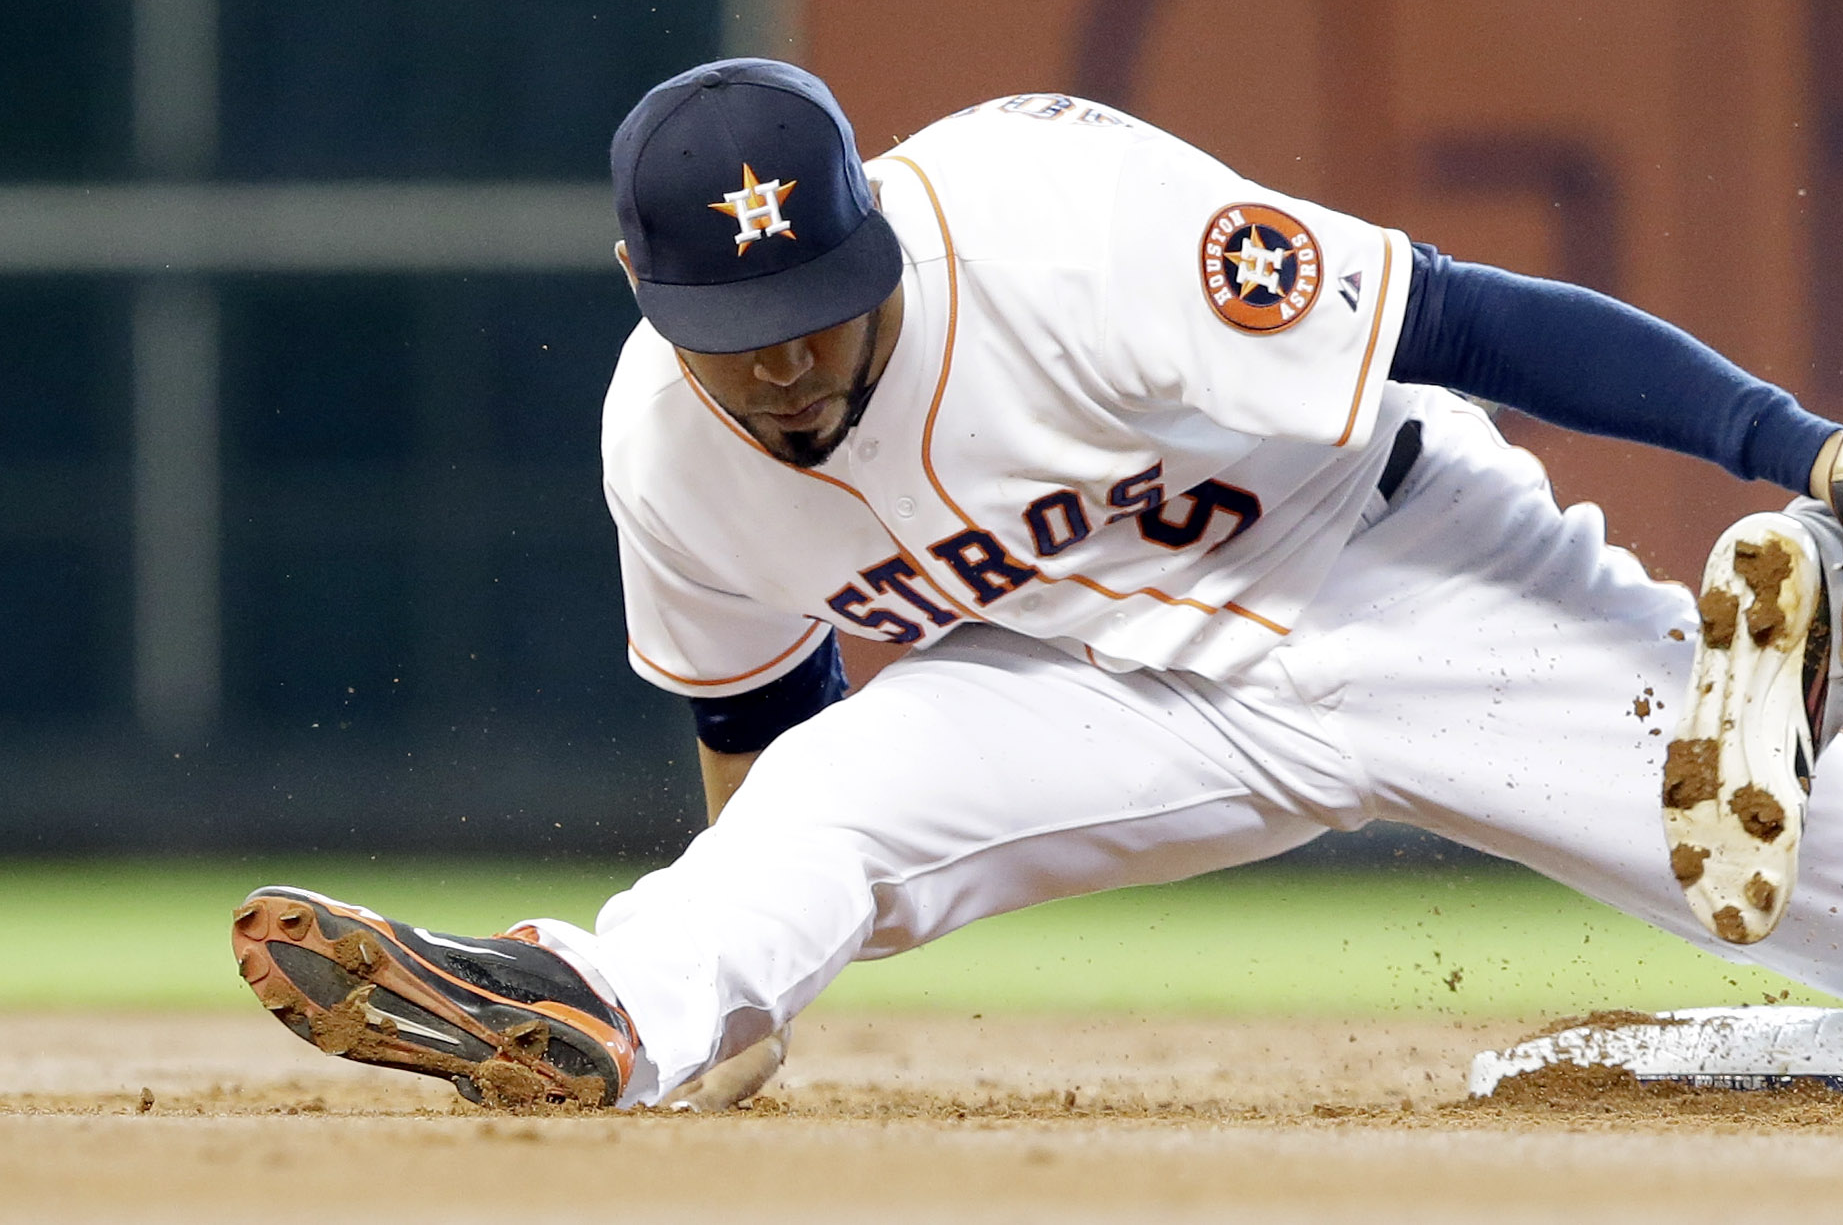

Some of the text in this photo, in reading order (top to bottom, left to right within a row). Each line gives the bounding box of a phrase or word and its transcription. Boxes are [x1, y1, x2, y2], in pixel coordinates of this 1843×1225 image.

[723, 178, 791, 245] H
[1205, 209, 1246, 306] HOUSTON
[1236, 237, 1285, 294] H
[1279, 233, 1317, 320] ASTROS
